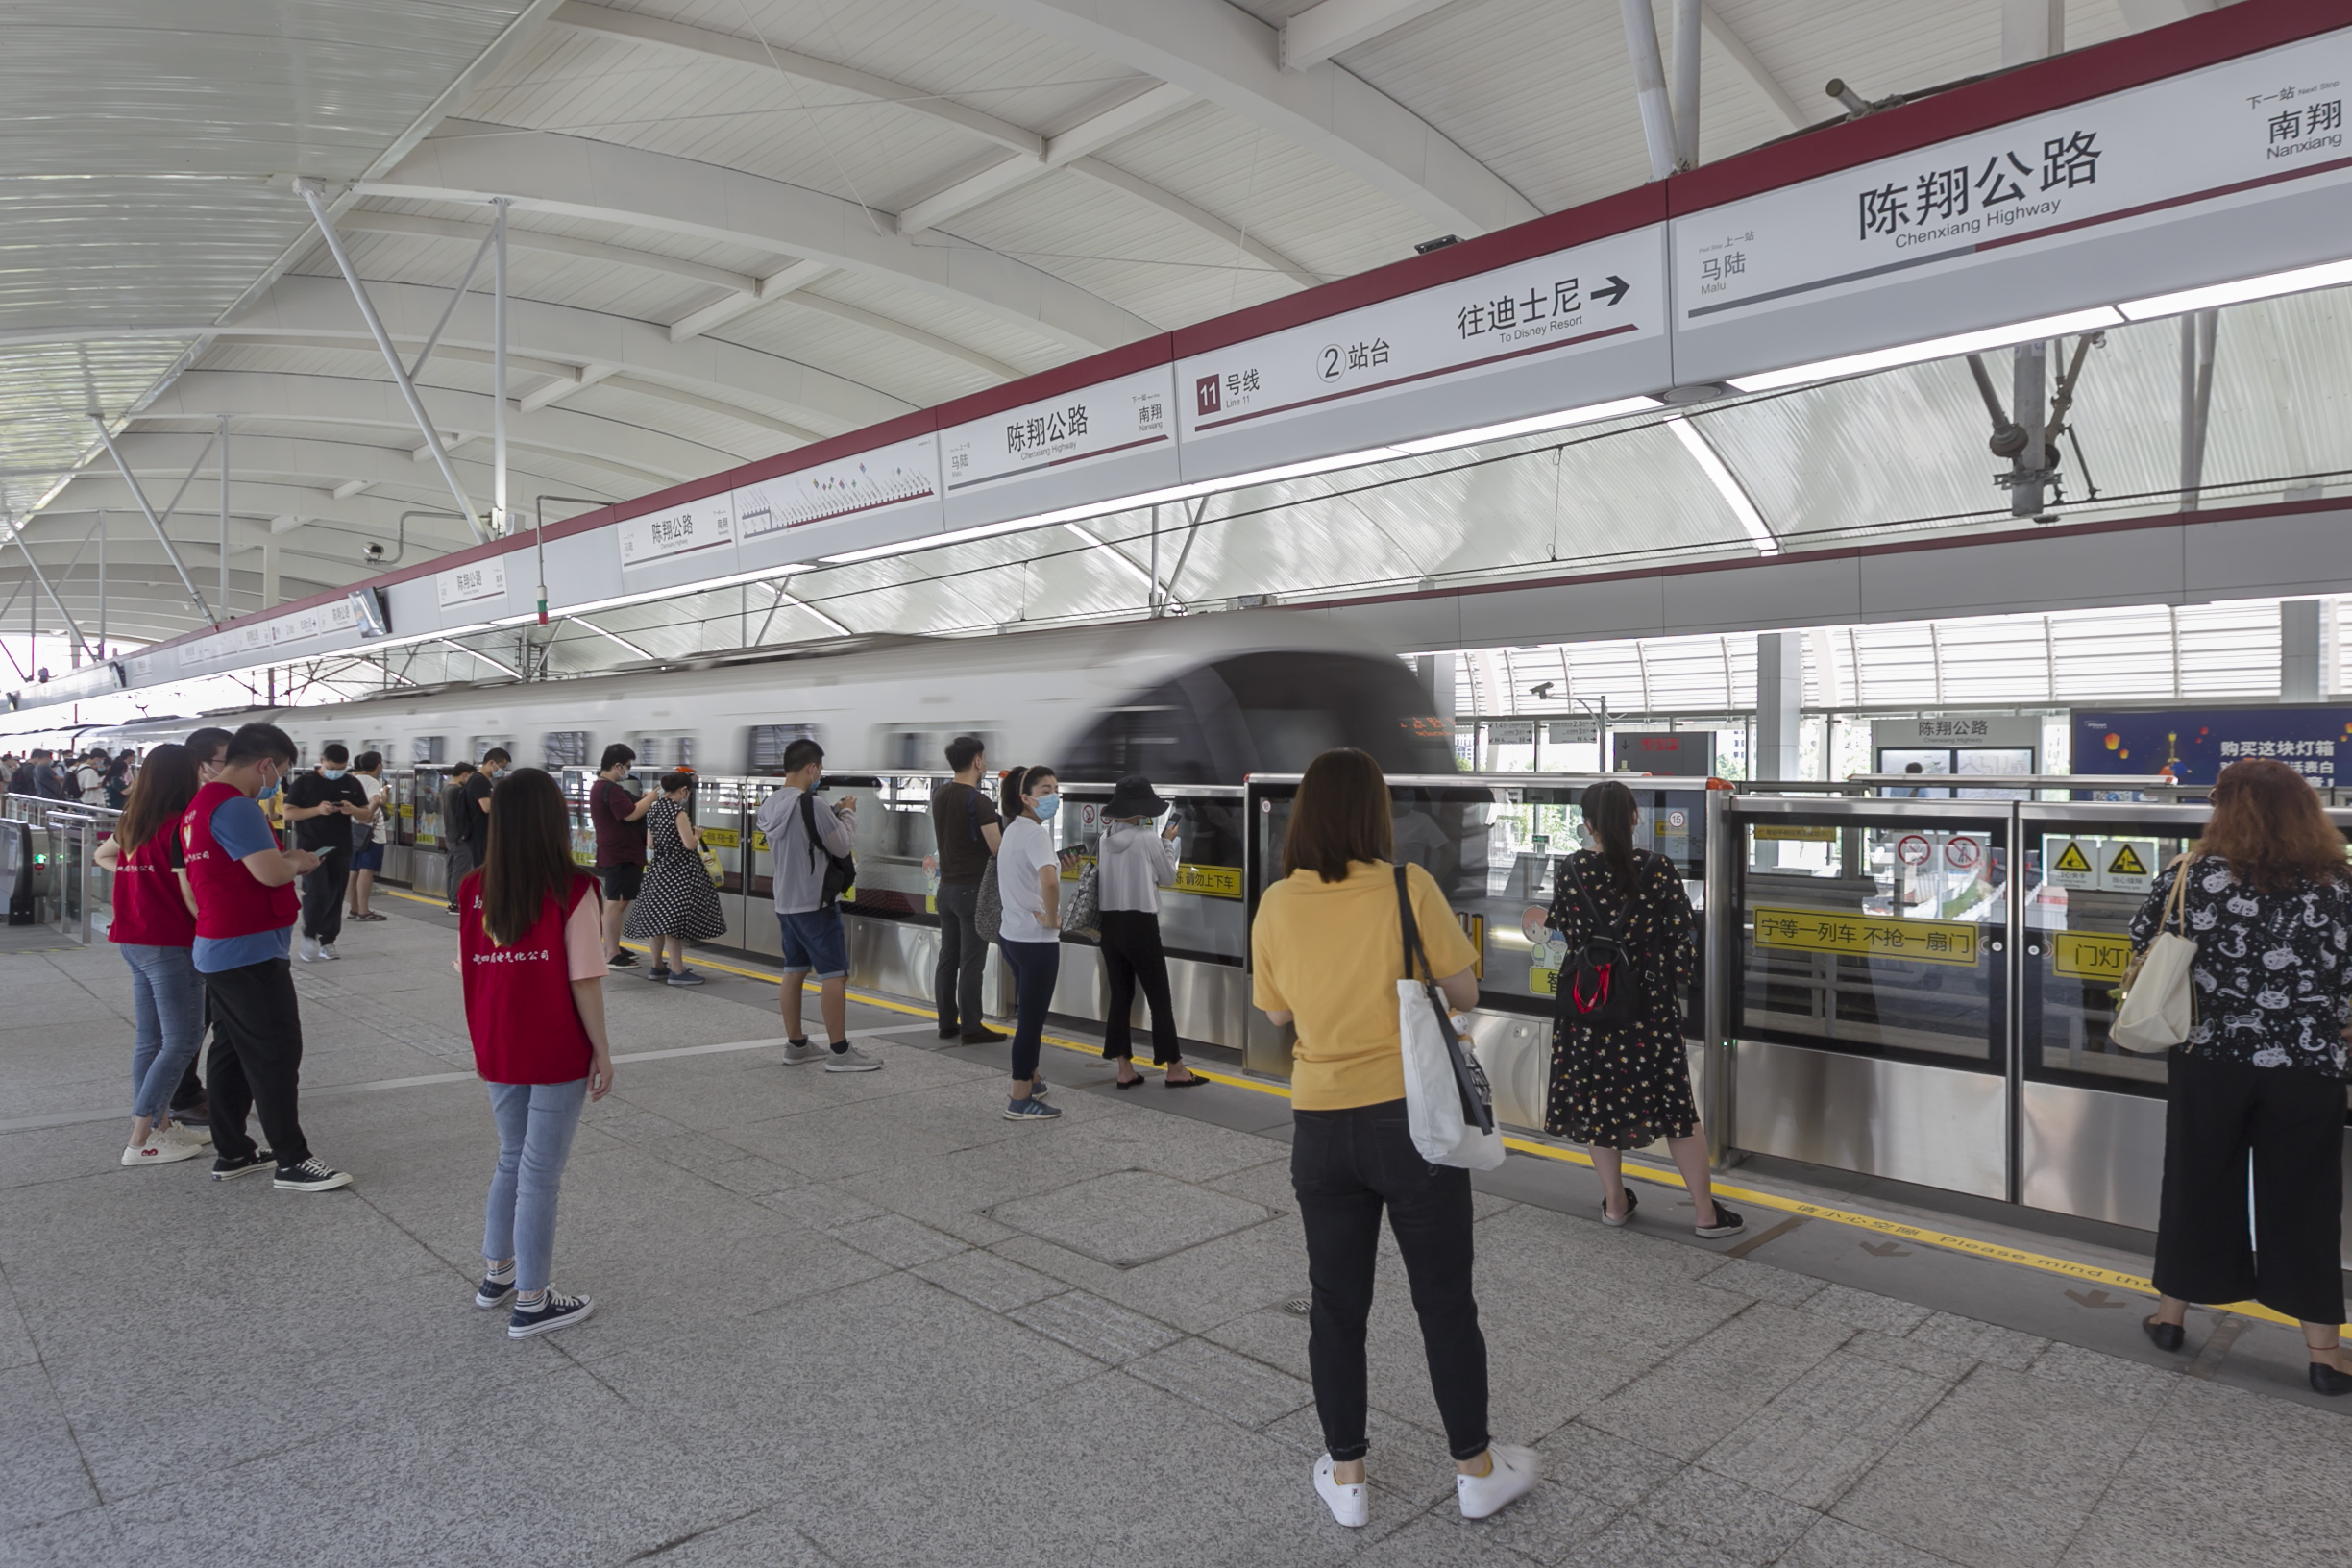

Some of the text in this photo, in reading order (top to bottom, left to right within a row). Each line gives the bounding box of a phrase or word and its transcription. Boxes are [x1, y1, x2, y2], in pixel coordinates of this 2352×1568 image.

[2245, 86, 2296, 110] 下一站
[2297, 81, 2340, 96] Next Stop
[2268, 99, 2342, 145] 南翔
[2266, 134, 2342, 160] Nanxiang
[1859, 130, 2103, 241] 陈翔公路
[1895, 199, 2061, 249] Chenxiang Highway
[1724, 231, 1754, 248] 上一站
[1701, 251, 1746, 281] 马陆
[1701, 282, 1727, 295] Malu
[1458, 277, 1582, 339] 往迪士尼
[1500, 315, 1583, 344] To Disney Resort
[1348, 338, 1390, 371] 站台
[1200, 382, 1217, 407] 11
[1226, 368, 1261, 396] 号线
[1139, 404, 1163, 424] 南翔
[1225, 395, 1251, 408] Line 11
[1007, 404, 1089, 453] 陈翔公路
[1139, 421, 1163, 432] Nanxiang
[951, 453, 968, 470] 马陆
[1020, 441, 1077, 461] Chenxiang Highway
[651, 513, 693, 544] 陈翔公路
[1919, 720, 1989, 736] 陈翔公路
[2220, 740, 2335, 757] 购买这块灯箱
[1672, 815, 1681, 824] 15
[1186, 872, 1234, 889] 请勿上下车
[1761, 918, 1969, 954] 宁等一列车 不抢一扇门
[1939, 1237, 2026, 1261] Please
[2037, 1259, 2103, 1277] mind
